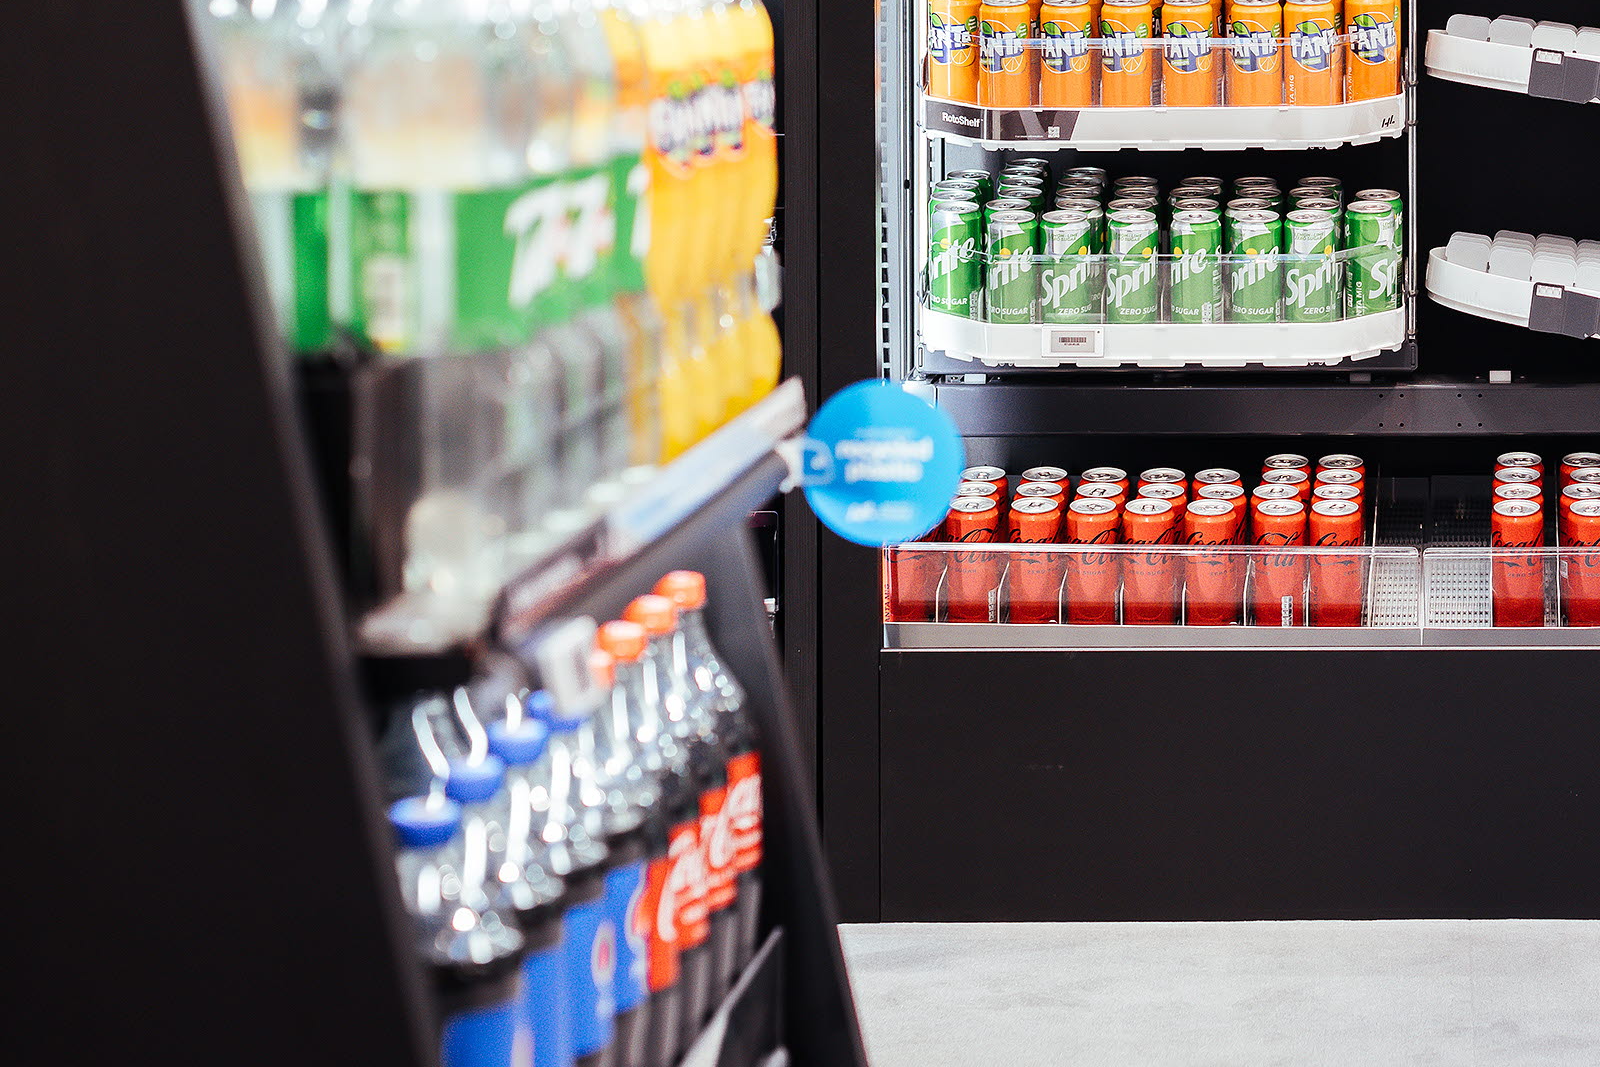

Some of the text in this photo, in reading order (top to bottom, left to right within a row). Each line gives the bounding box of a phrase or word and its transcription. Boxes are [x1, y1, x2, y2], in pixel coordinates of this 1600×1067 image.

[942, 111, 981, 128] RotoShelf
[1058, 307, 1080, 315] ZERO
[1119, 307, 1142, 315] ZERO
